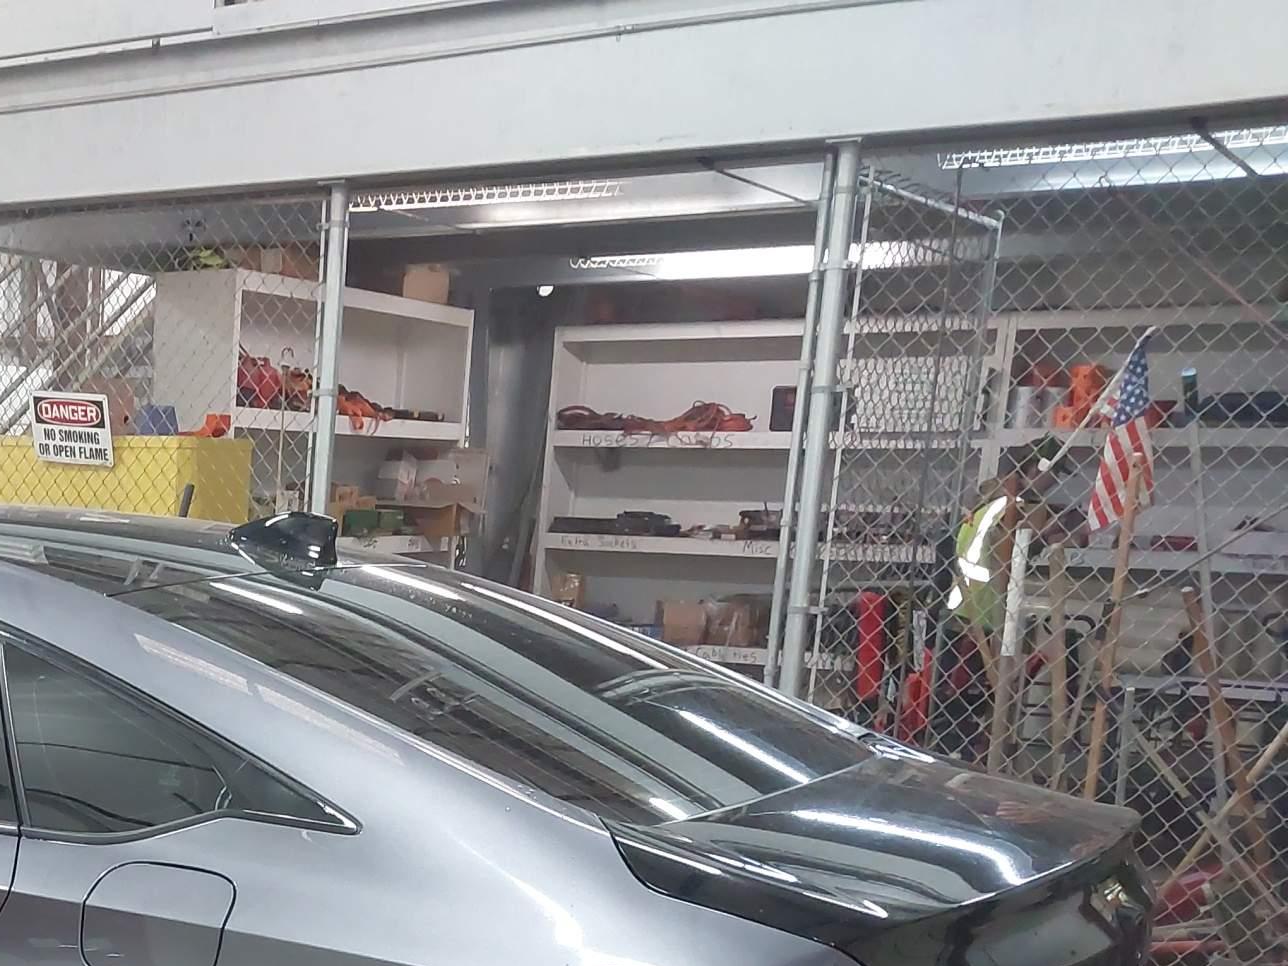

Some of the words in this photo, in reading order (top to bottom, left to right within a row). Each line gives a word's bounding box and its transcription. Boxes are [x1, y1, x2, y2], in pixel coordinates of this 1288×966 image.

[41, 403, 97, 422] DANGER
[43, 428, 56, 441] NO
[58, 429, 100, 445] SMOKING
[39, 443, 51, 457] OR
[53, 445, 76, 459] OPEN
[78, 446, 110, 461] FLAME
